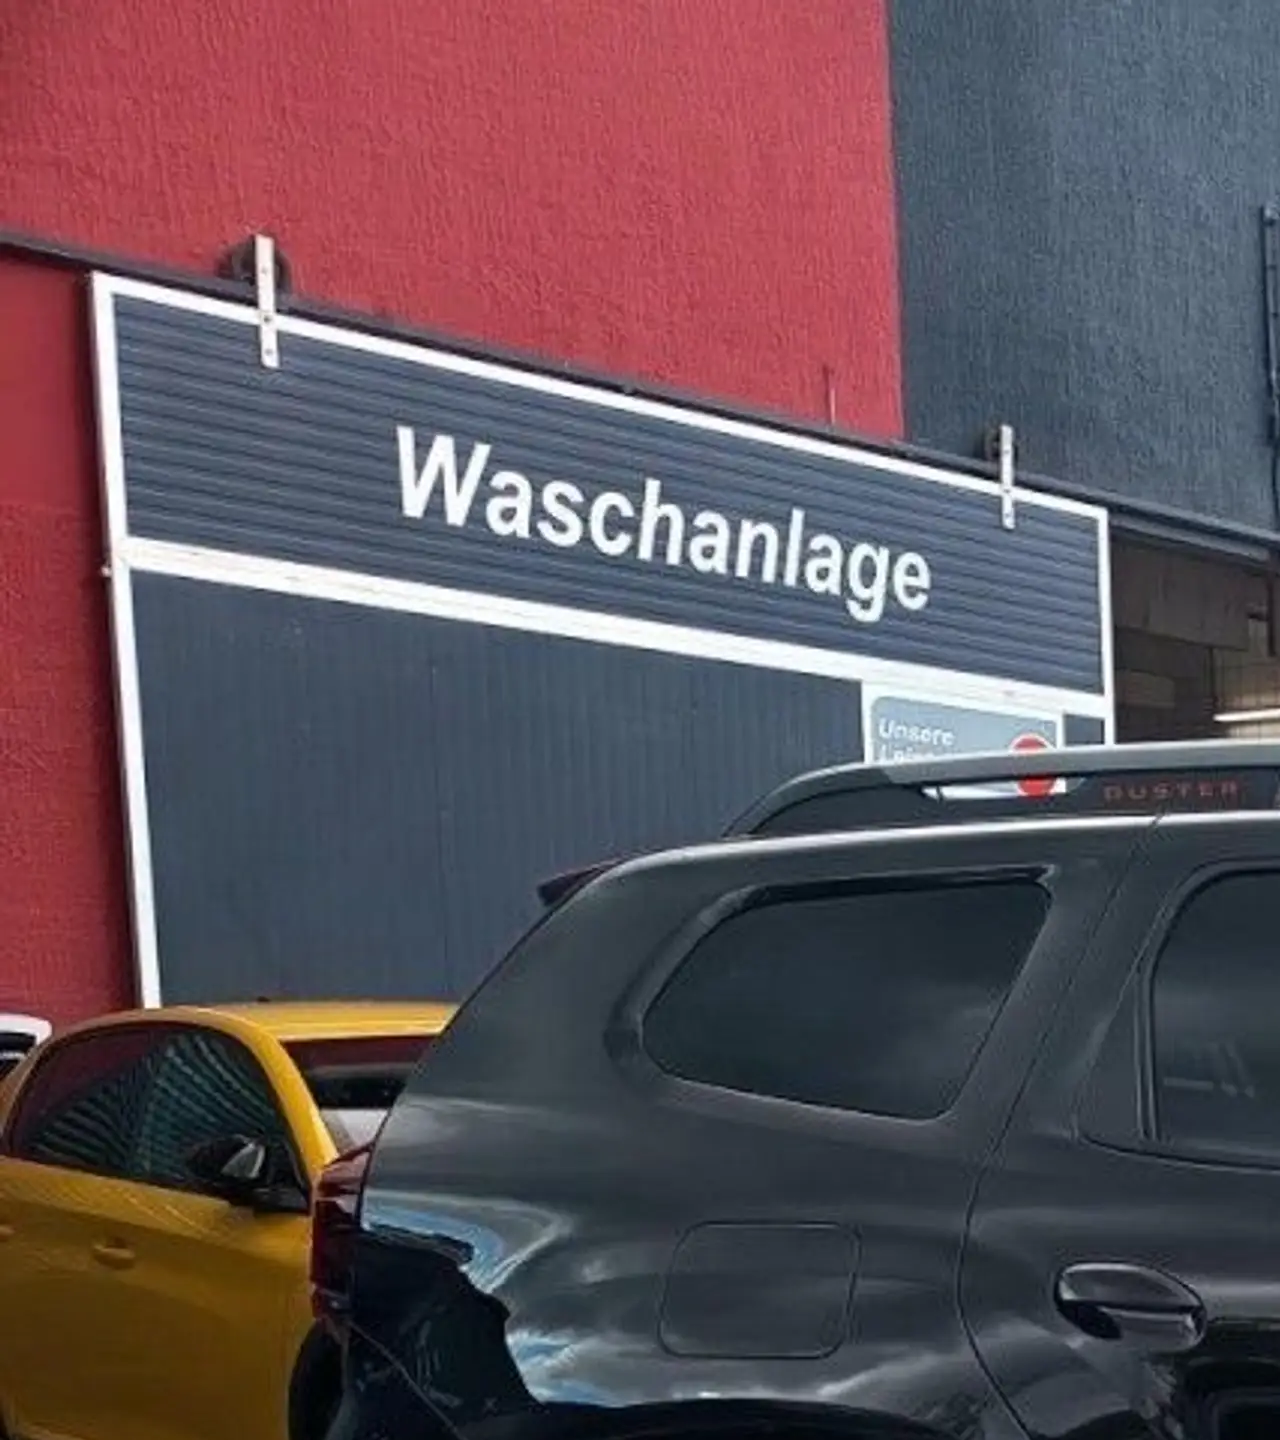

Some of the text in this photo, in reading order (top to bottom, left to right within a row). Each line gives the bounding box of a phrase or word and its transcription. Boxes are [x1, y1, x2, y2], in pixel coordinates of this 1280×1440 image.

[395, 424, 933, 624] Waschanlage
[878, 717, 955, 747] Unsere
[1102, 780, 1239, 802] DUSTER
